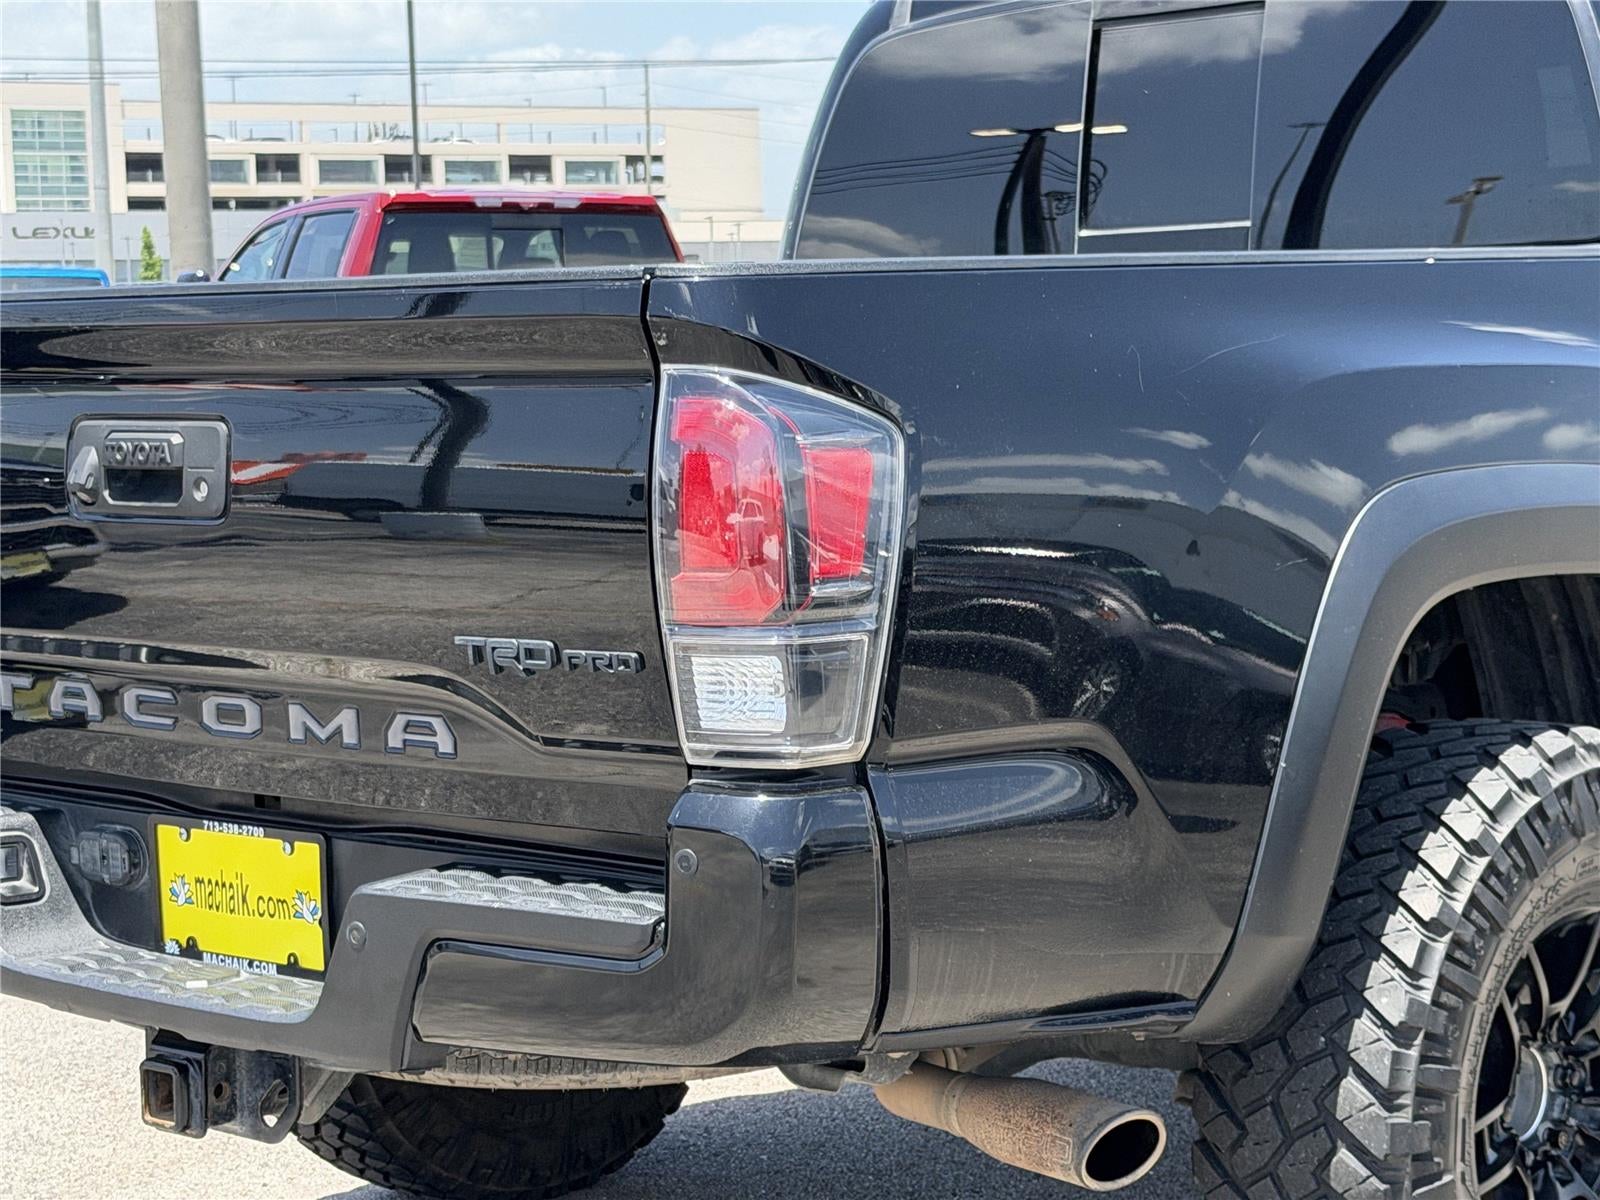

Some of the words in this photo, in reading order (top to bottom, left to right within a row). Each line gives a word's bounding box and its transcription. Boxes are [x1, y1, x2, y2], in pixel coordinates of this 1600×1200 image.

[105, 441, 172, 465] TOYOTA
[453, 635, 560, 677] TRD
[562, 649, 646, 674] PRO
[0, 672, 457, 758] TACOMA
[194, 869, 292, 920] machaik.com
[202, 952, 278, 976] MACHAIK.COM
